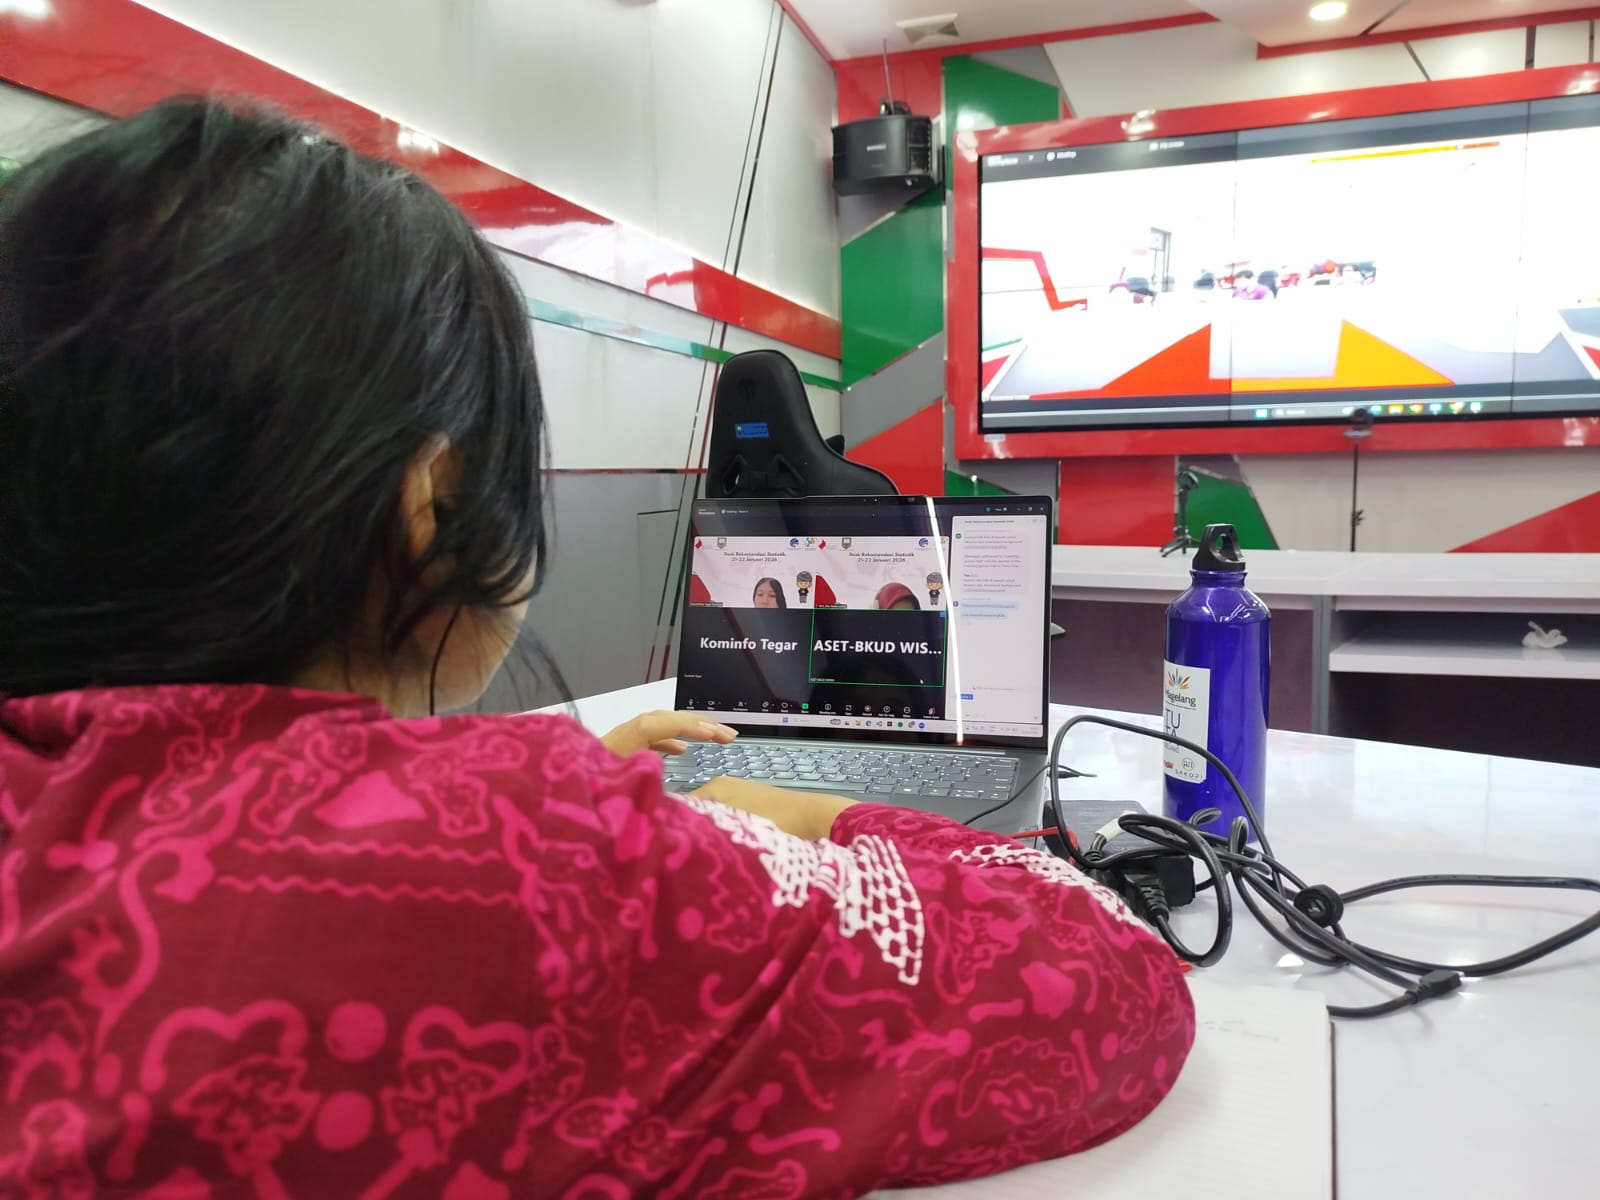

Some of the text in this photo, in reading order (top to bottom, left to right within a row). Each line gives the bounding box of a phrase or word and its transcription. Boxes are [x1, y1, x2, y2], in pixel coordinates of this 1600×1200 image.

[700, 637, 798, 653] Kominfo Tegar
[813, 640, 942, 655] ASET-BKUD WIS...
